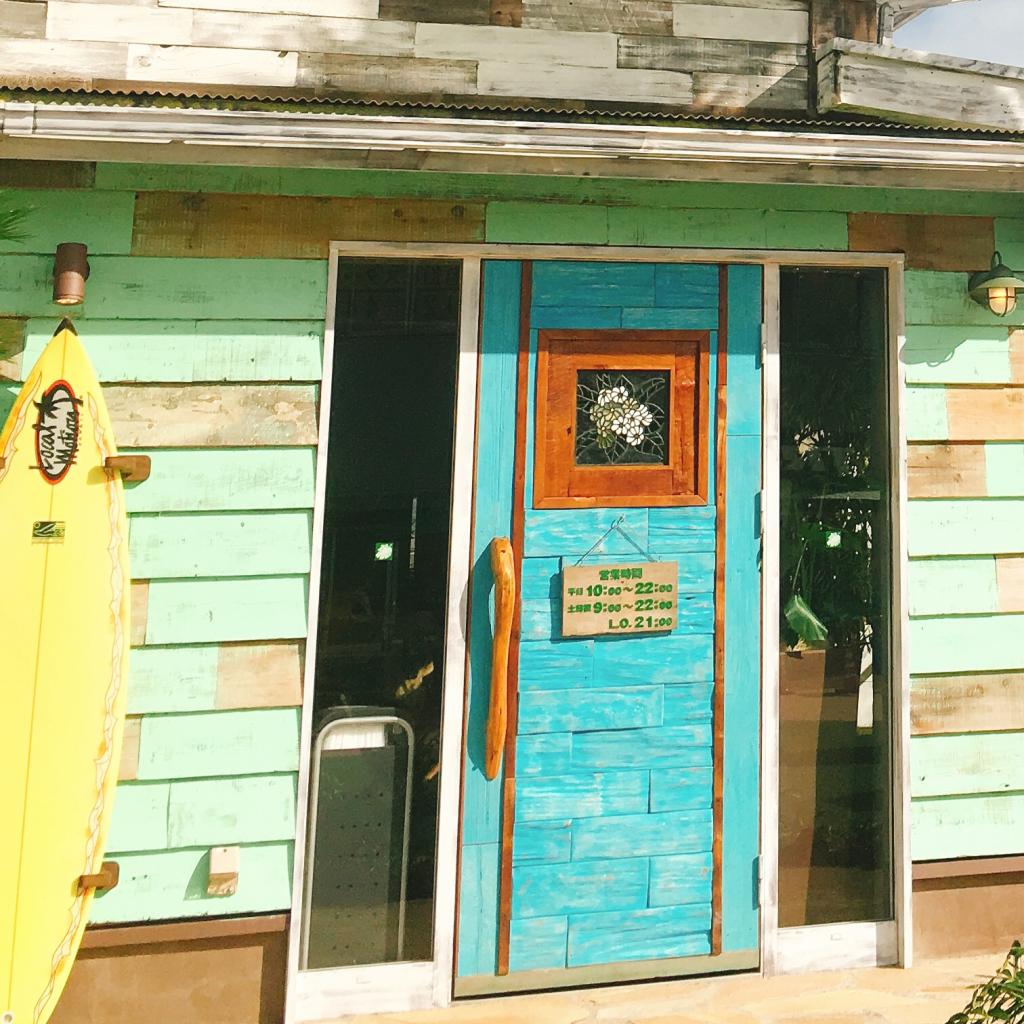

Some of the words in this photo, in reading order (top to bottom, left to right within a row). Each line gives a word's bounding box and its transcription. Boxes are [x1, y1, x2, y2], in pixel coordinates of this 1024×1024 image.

[599, 568, 643, 581] 営業時間
[634, 616, 673, 629] 21:00
